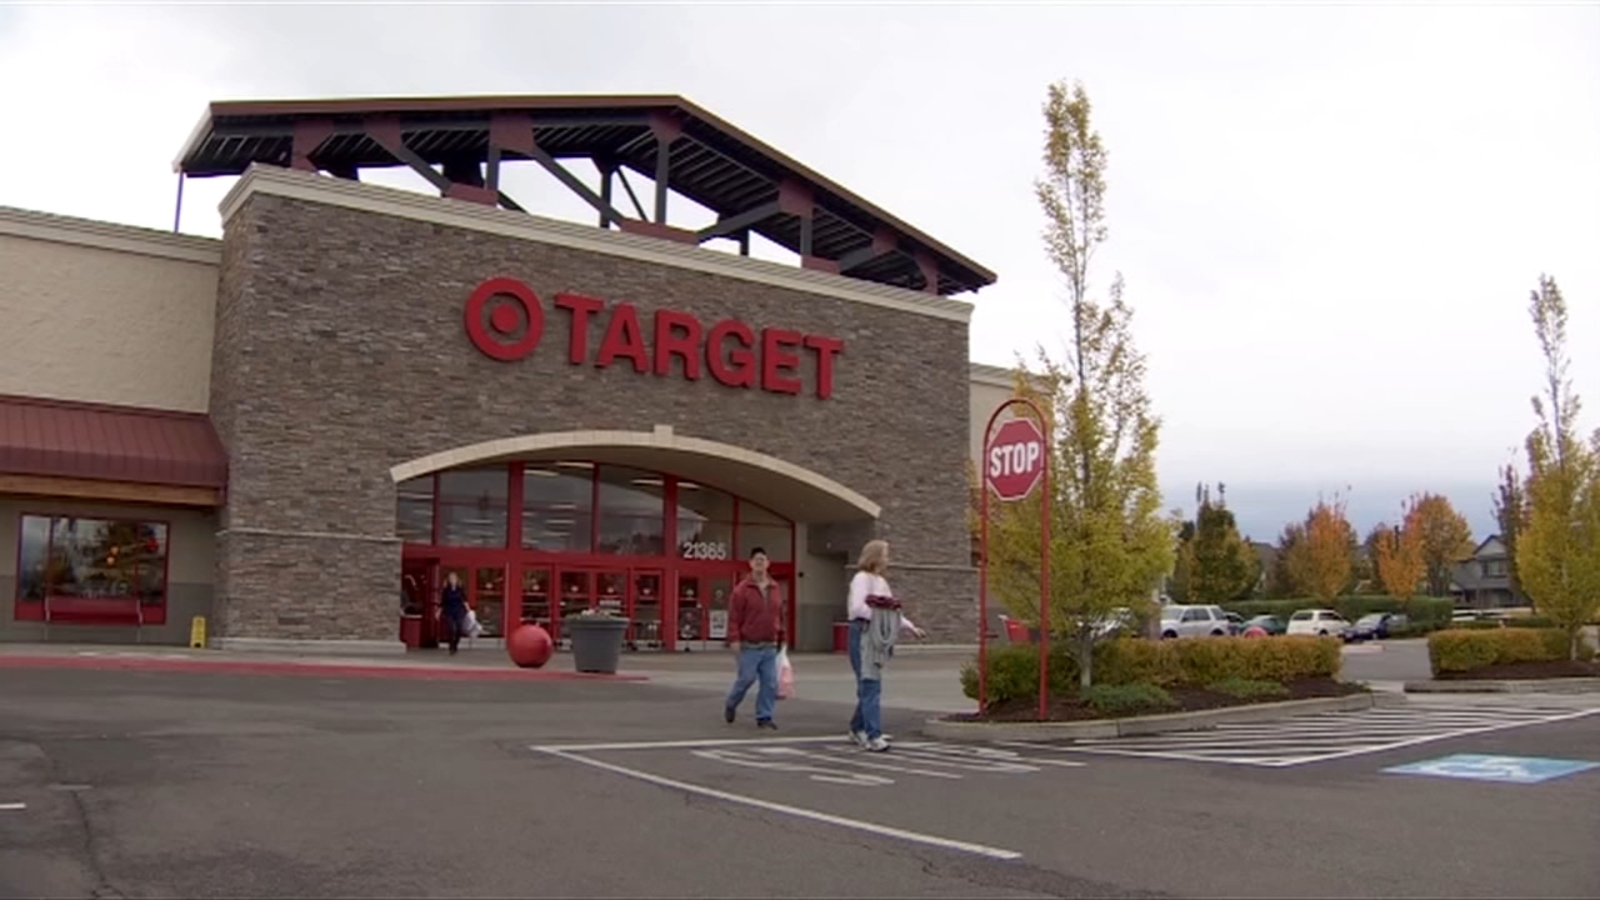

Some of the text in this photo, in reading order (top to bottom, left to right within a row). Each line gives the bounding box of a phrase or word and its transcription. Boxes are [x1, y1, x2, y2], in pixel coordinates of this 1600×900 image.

[554, 291, 844, 400] TARGET
[990, 441, 1040, 478] STOP
[683, 542, 726, 560] 21365
